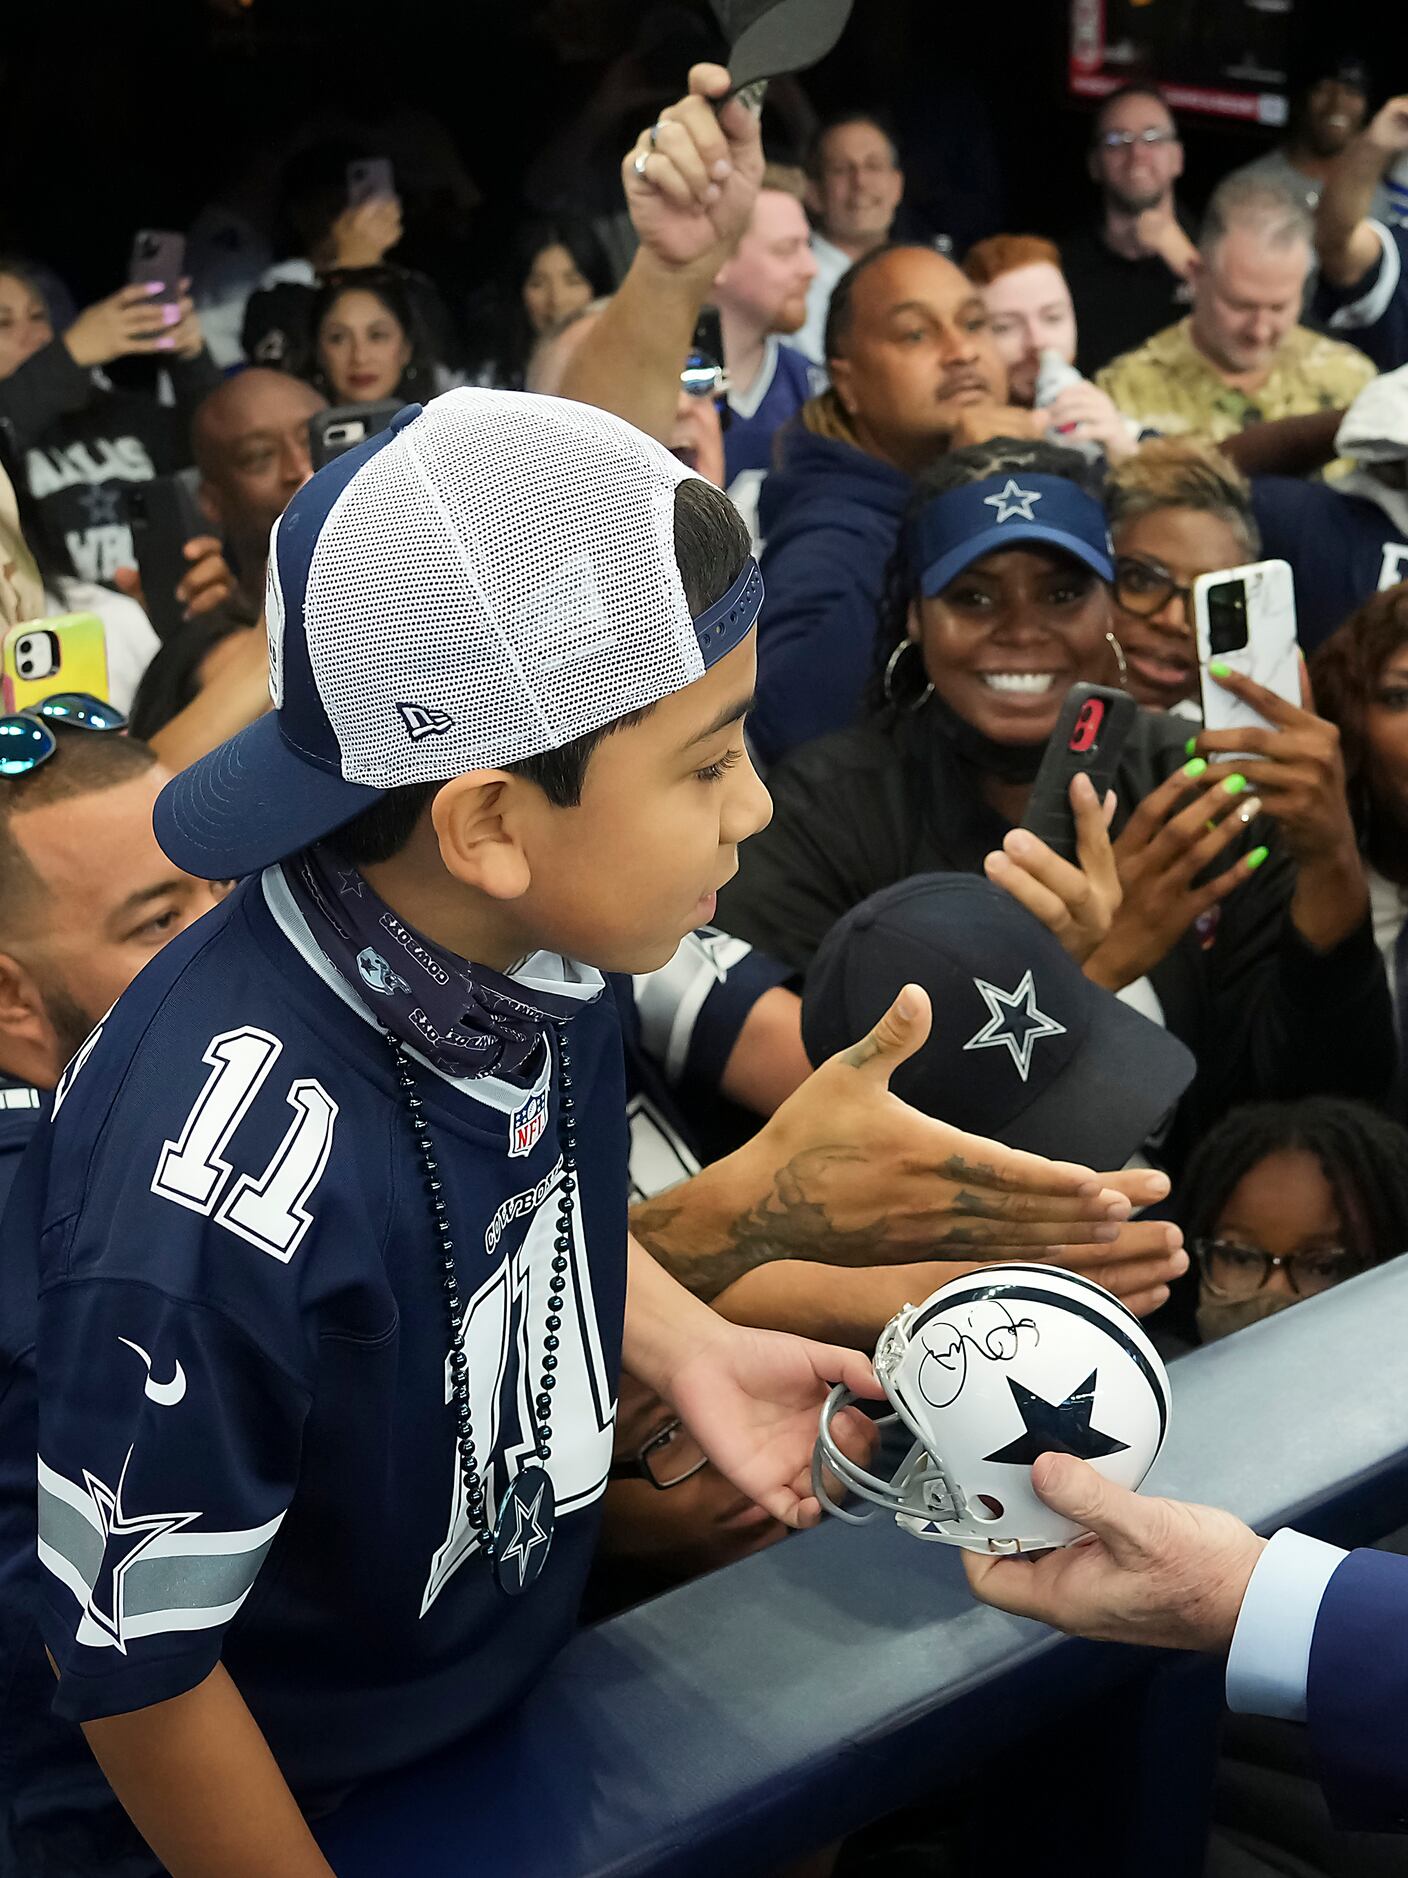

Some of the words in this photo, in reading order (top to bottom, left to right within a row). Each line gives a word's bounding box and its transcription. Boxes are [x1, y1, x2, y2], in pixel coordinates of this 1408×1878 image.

[379, 913, 449, 985] COWBOYS
[150, 1025, 339, 1264] 11
[516, 1114, 545, 1151] NFL
